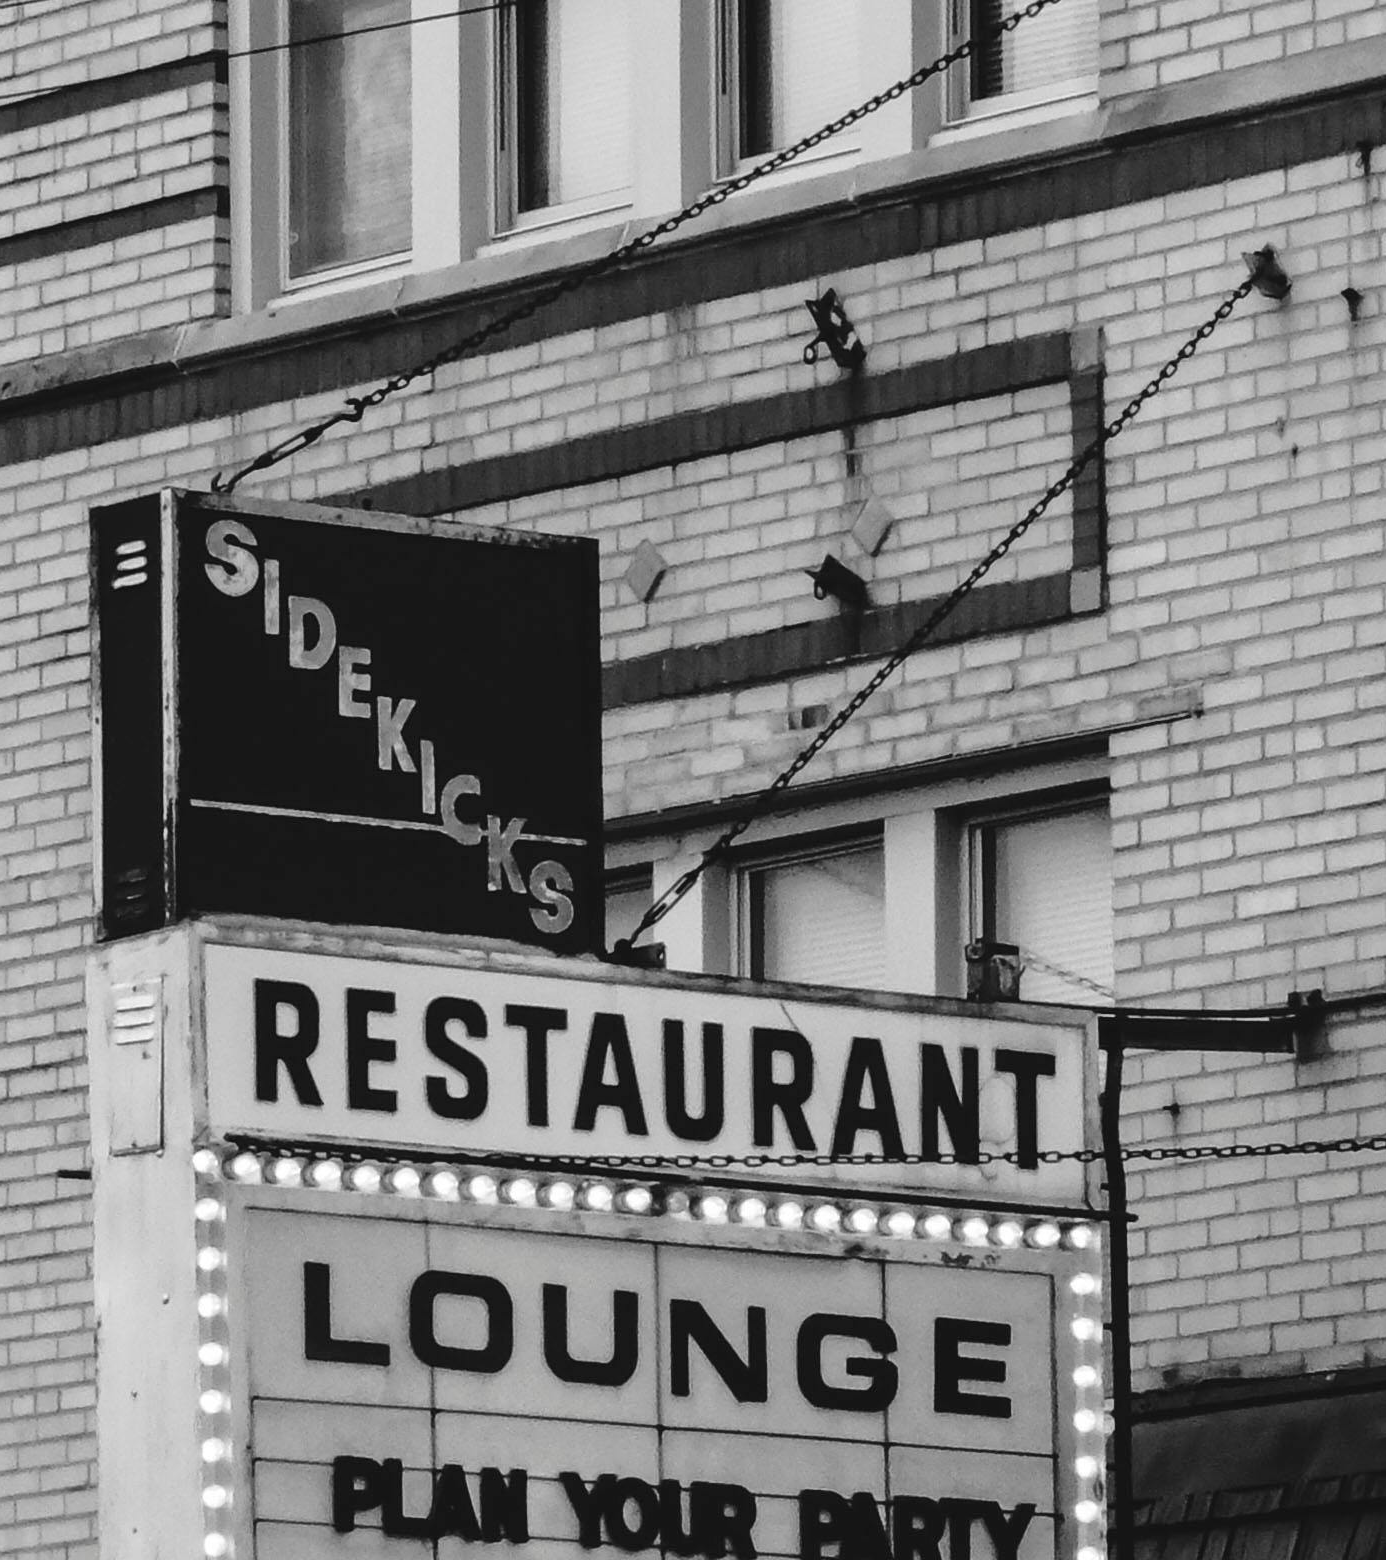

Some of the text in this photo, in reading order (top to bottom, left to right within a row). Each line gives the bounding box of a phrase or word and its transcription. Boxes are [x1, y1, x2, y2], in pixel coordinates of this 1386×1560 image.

[204, 520, 575, 934] SIDEKICKS
[253, 977, 1056, 1170] RESTAURANT
[303, 1261, 1013, 1418] LOUNGE
[333, 1455, 529, 1543] PLAN
[559, 1471, 757, 1560] YOUR
